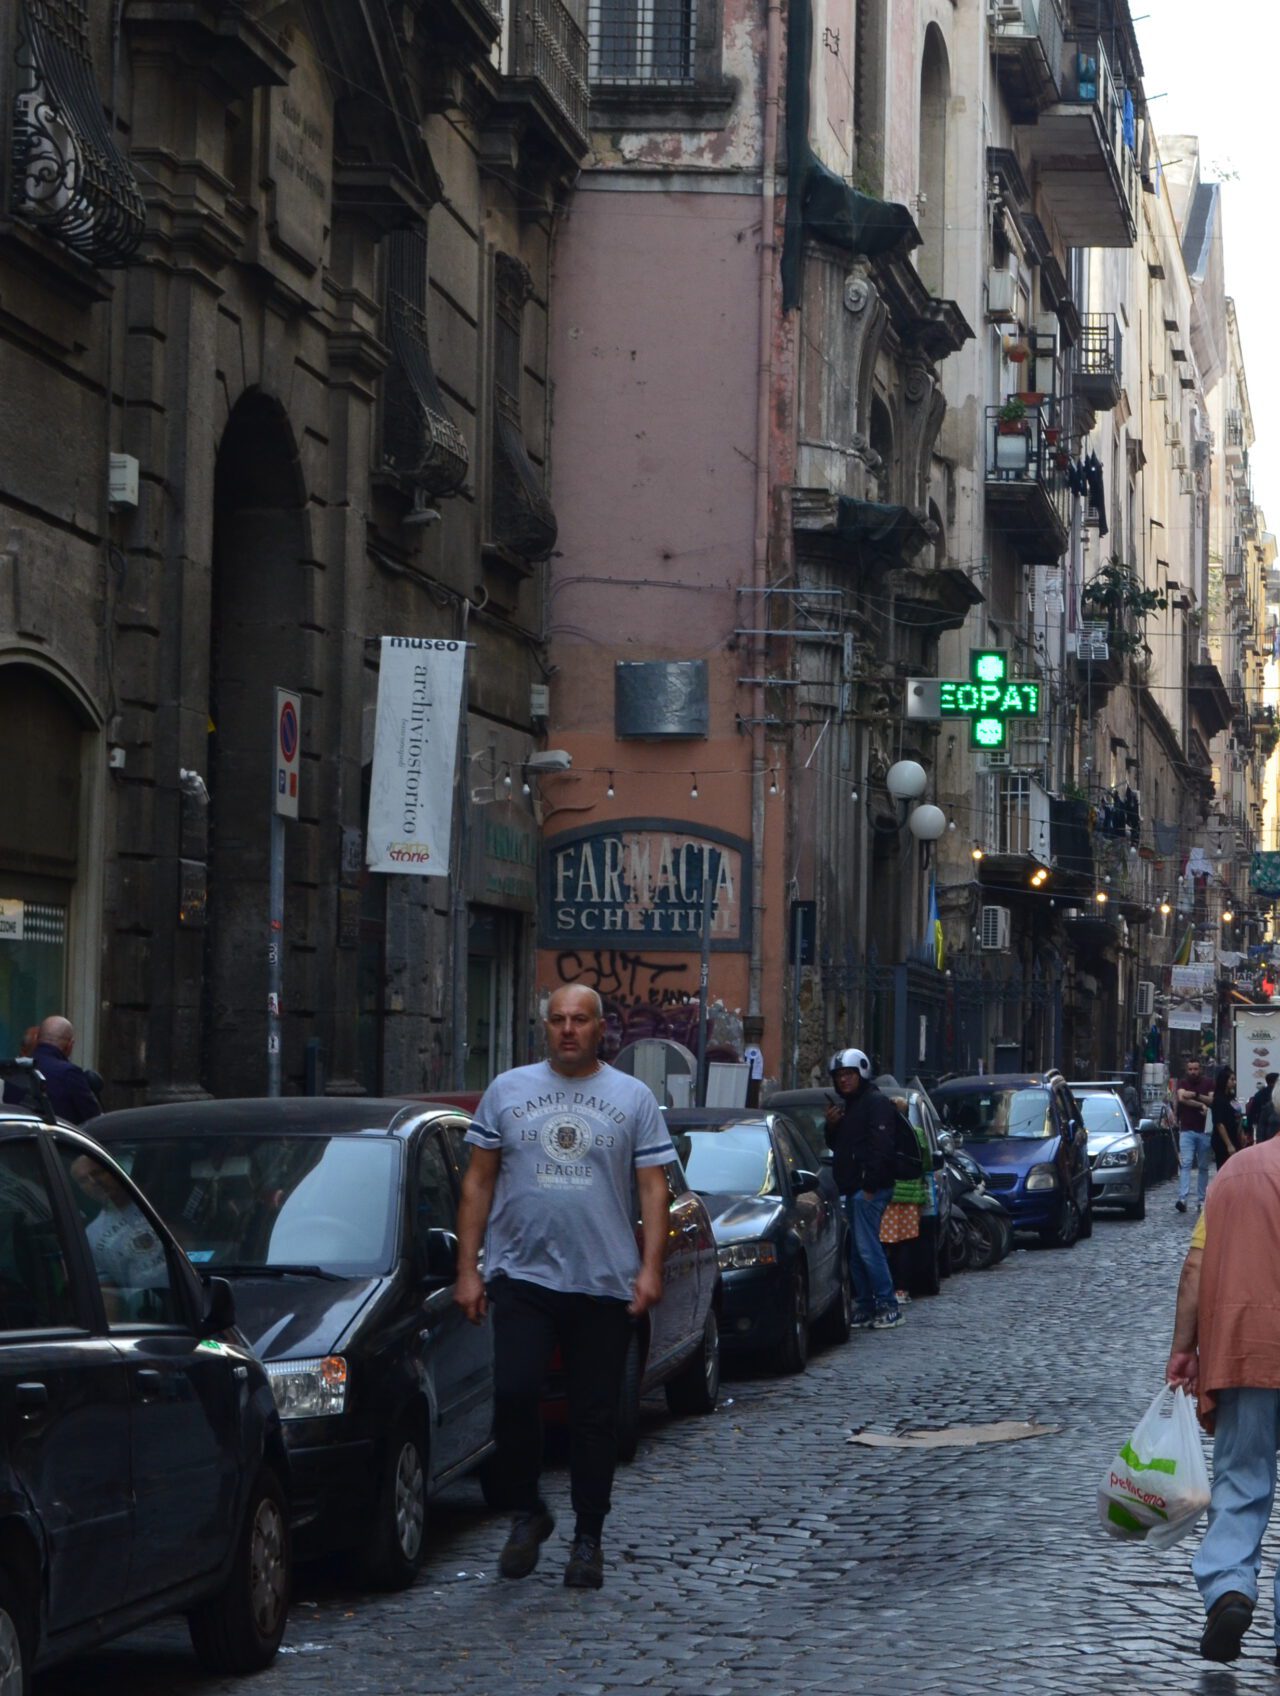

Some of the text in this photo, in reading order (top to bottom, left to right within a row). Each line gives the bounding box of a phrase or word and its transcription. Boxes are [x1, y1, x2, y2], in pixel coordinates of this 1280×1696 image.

[391, 637, 460, 652] museo
[402, 665, 433, 834] archiviostorico
[554, 838, 735, 904] FARMACIA
[512, 1092, 626, 1124] CAMP DAVID
[520, 1129, 615, 1148] 19 63
[536, 1163, 592, 1177] LEAGUE
[1110, 1471, 1166, 1509] pellicano
